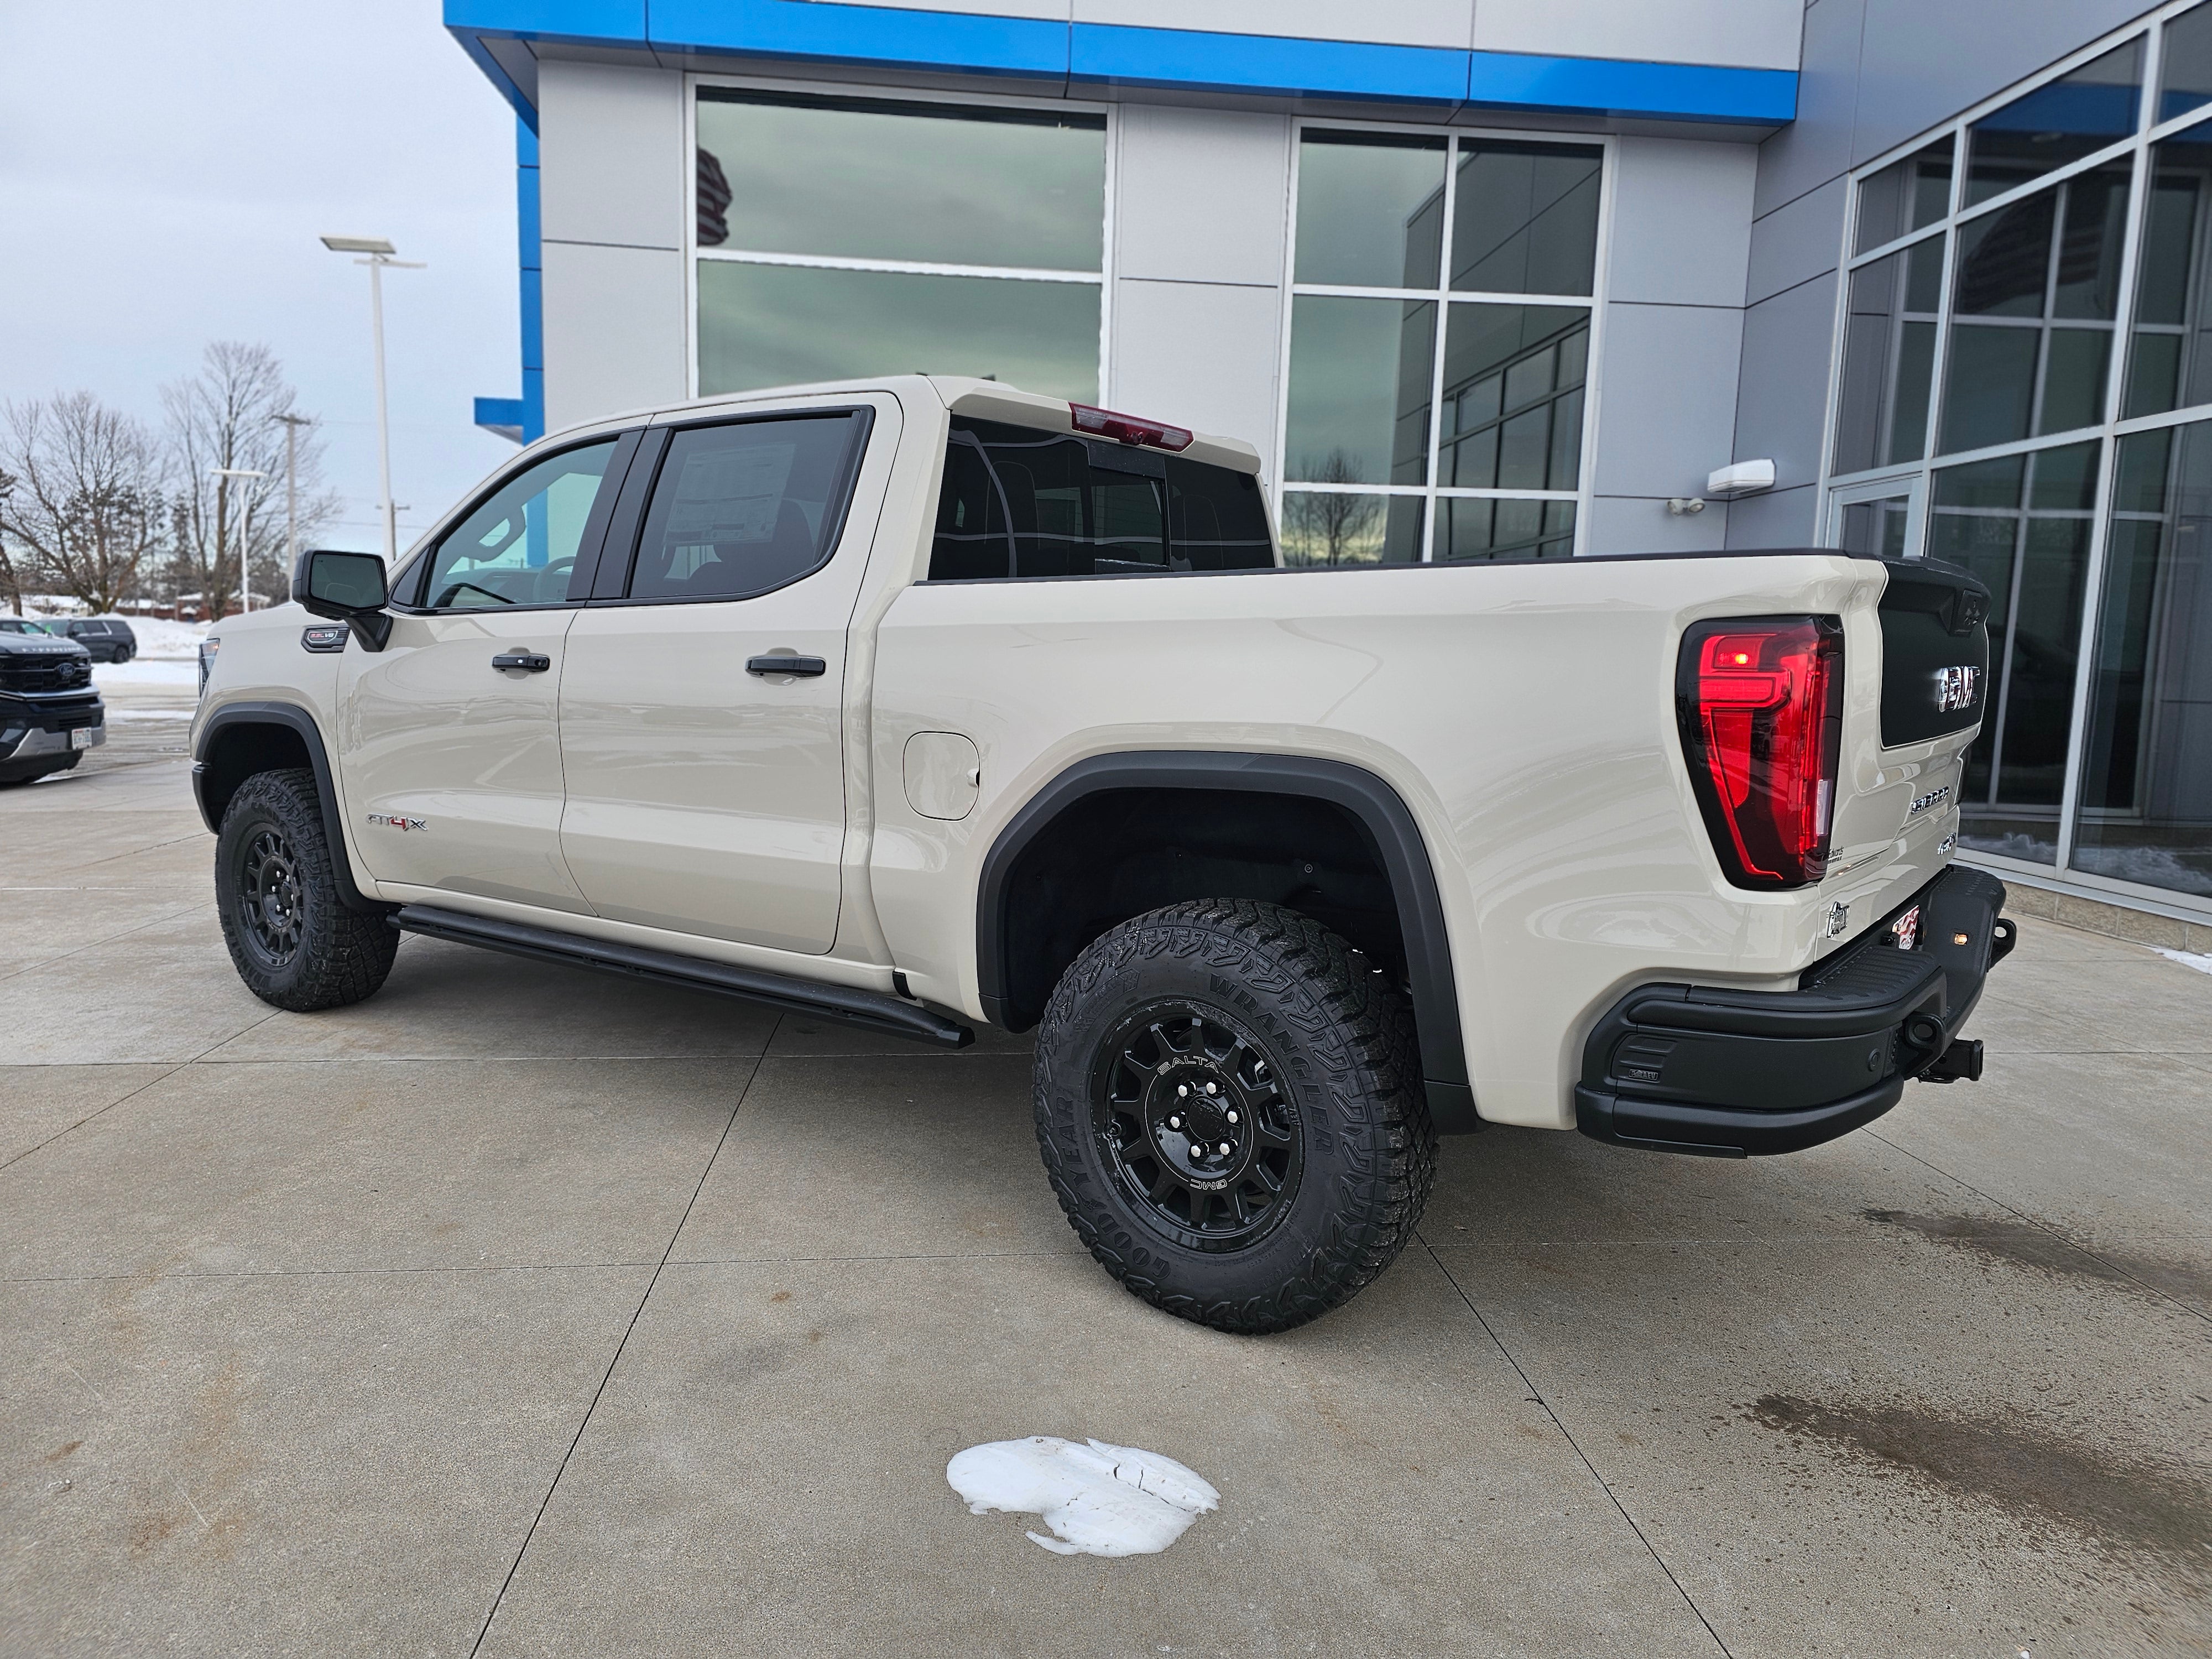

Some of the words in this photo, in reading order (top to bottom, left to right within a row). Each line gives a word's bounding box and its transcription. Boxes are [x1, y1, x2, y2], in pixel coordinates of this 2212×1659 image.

[366, 813, 428, 831] AT4X
[1157, 1056, 1219, 1075] SALTA
[1209, 973, 1333, 1155] WRANGLER
[1190, 1178, 1227, 1190] GMC
